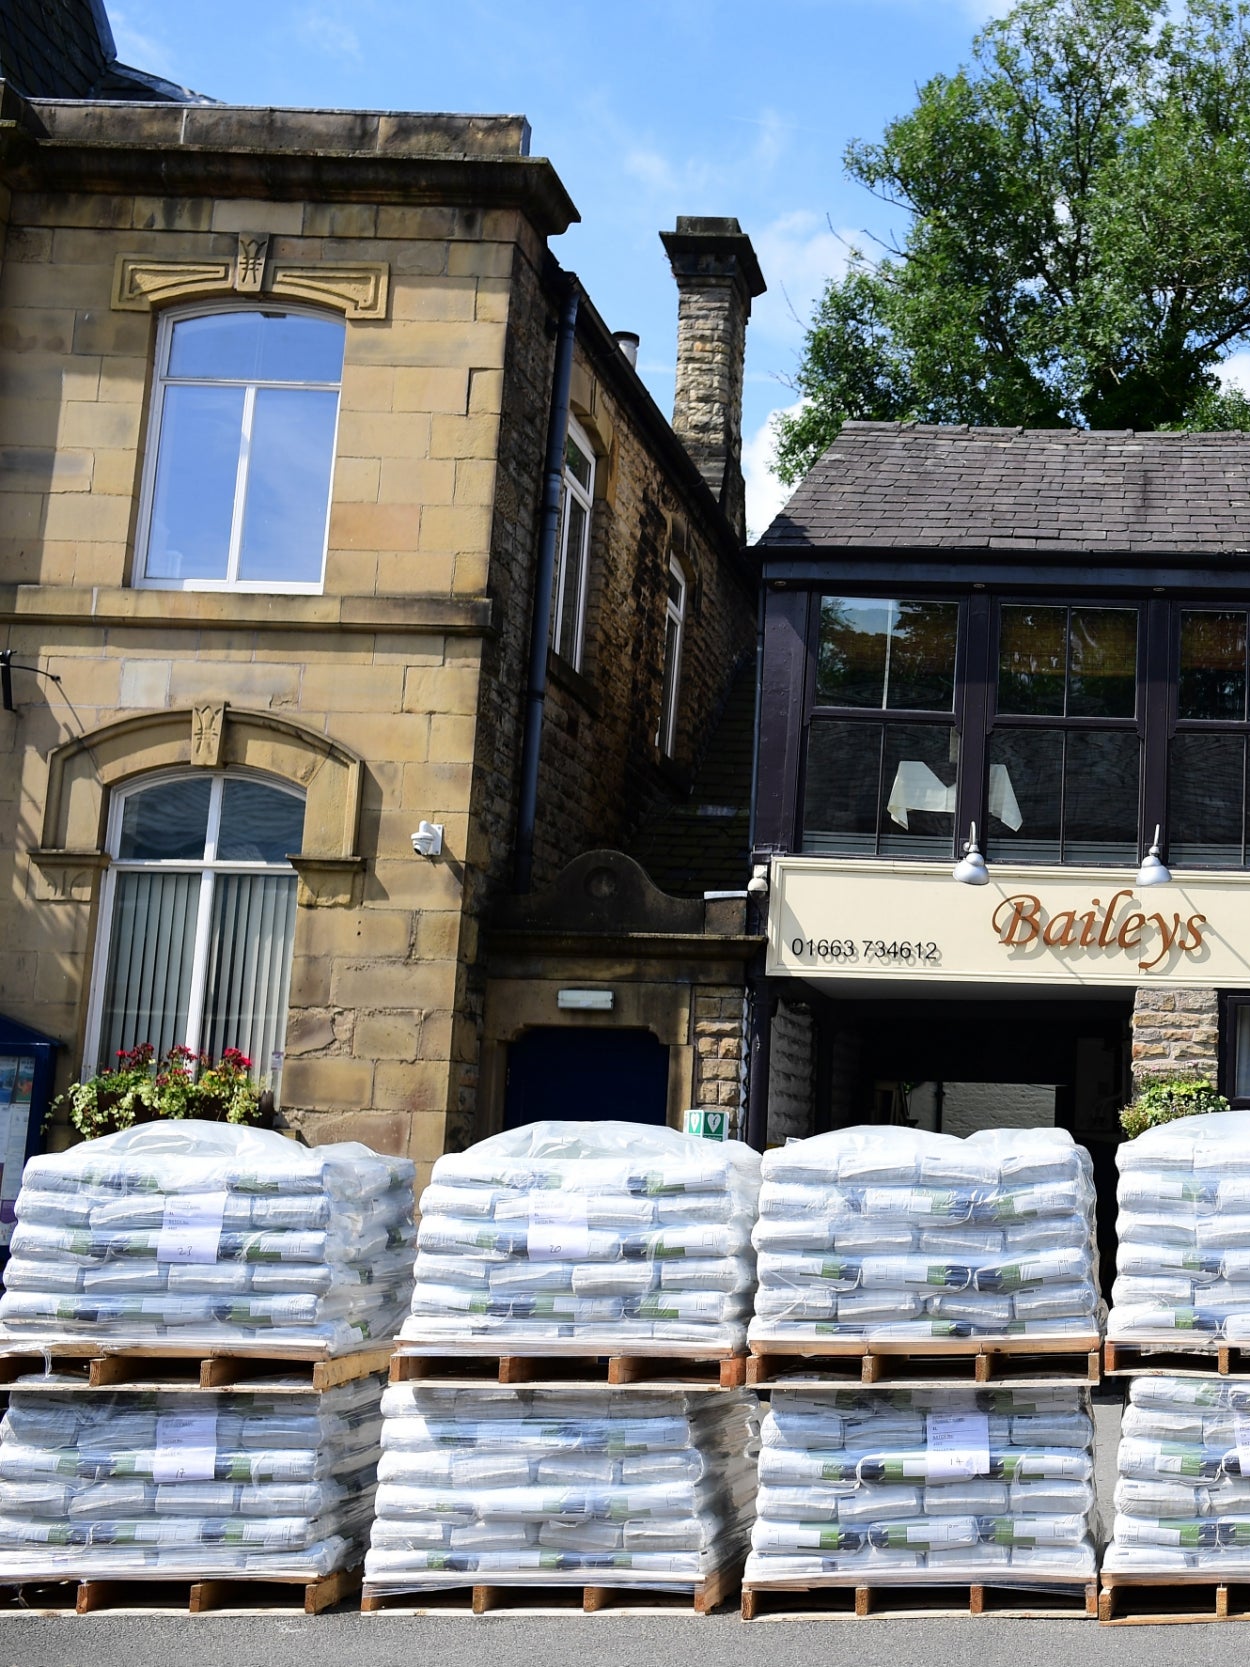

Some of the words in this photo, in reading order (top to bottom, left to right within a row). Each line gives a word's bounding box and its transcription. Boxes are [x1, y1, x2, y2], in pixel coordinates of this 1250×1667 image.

[791, 937, 855, 957] 01663
[862, 940, 937, 960] 734612
[991, 889, 1207, 969] Baileys
